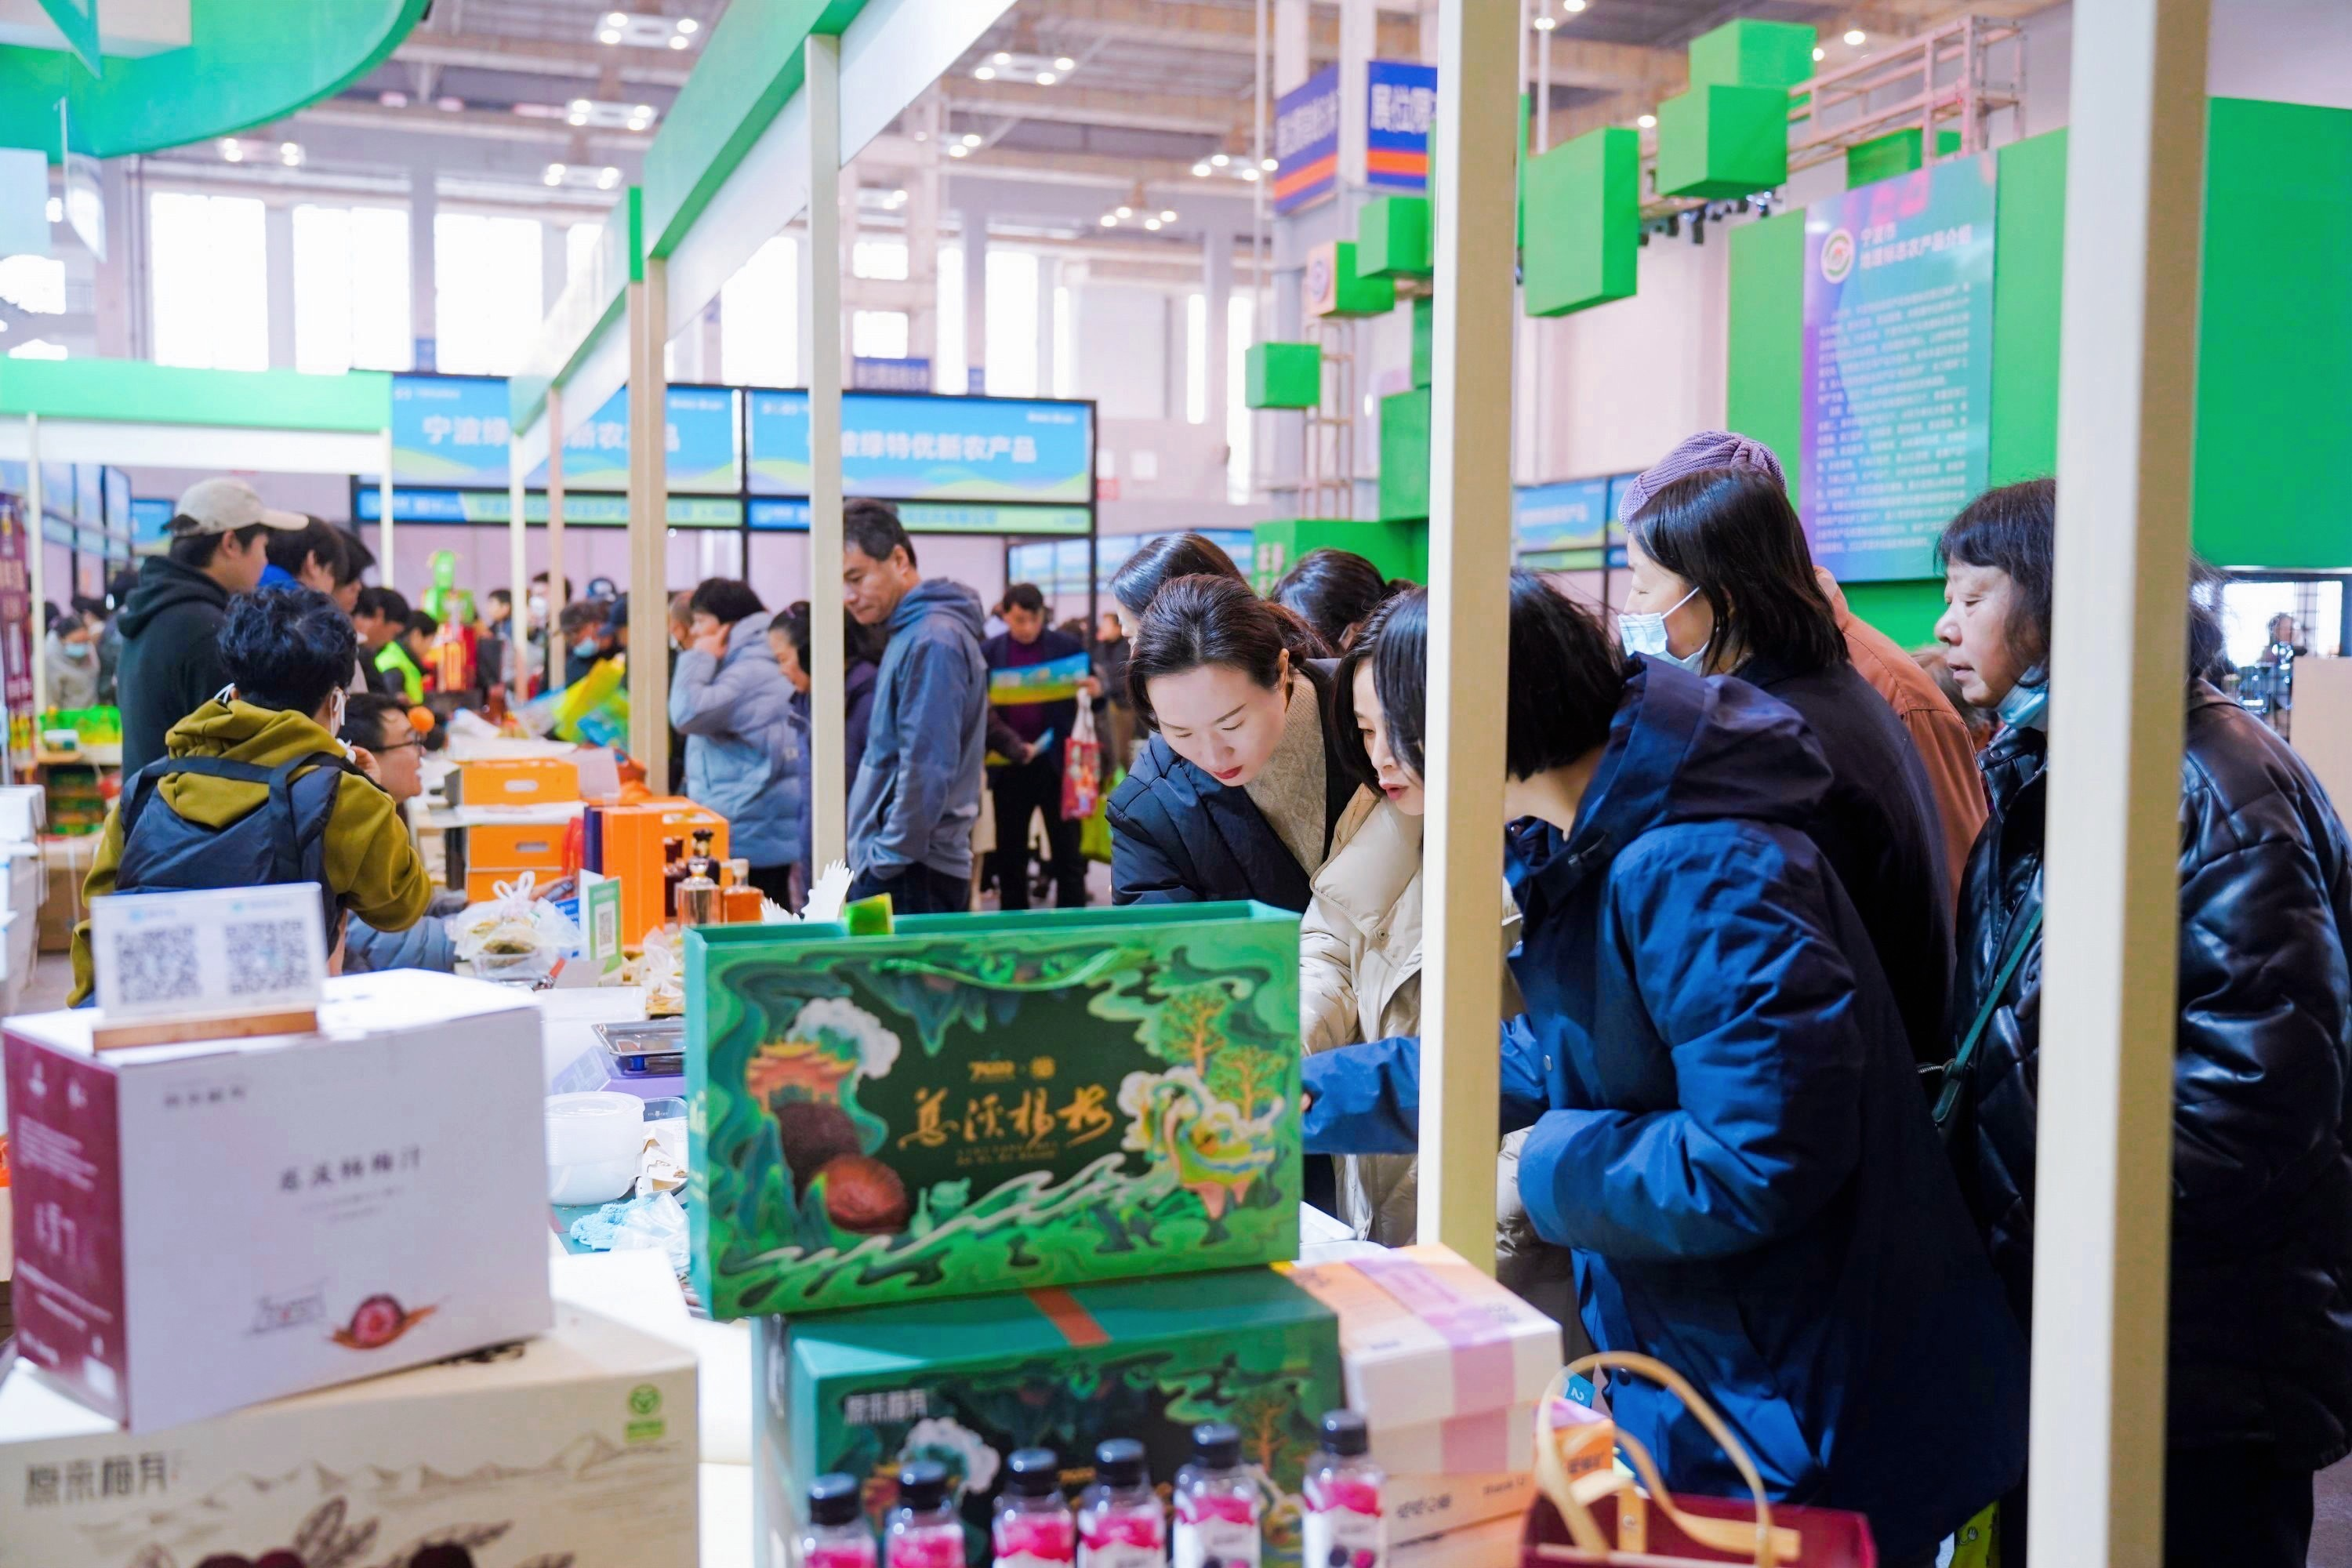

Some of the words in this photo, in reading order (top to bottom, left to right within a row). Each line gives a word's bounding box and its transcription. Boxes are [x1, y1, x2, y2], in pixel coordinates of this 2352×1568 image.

[806, 430, 1037, 463] 波绿特优新农产品
